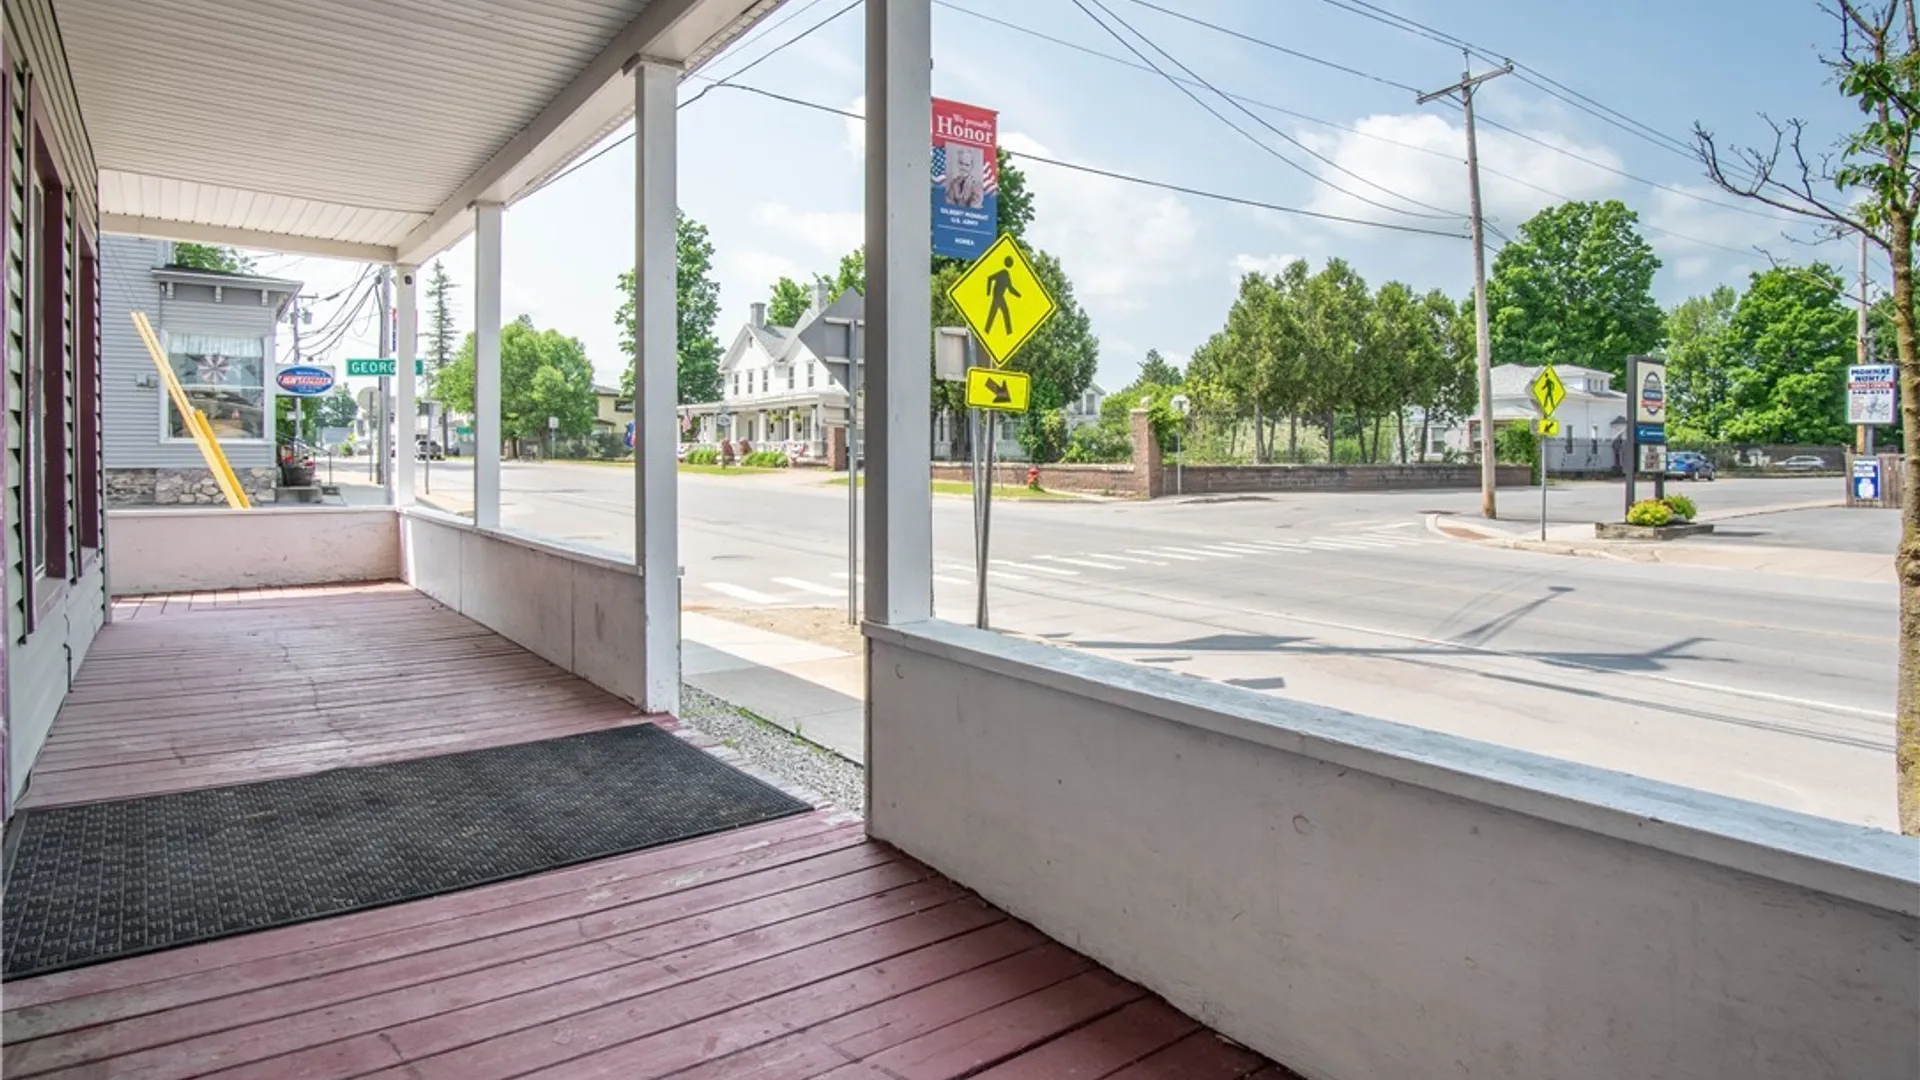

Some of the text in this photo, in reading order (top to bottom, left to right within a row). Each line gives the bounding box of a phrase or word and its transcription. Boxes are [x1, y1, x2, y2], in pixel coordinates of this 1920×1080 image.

[936, 114, 993, 143] Honor
[954, 237, 975, 246] KOREA
[351, 361, 395, 374] GEORG
